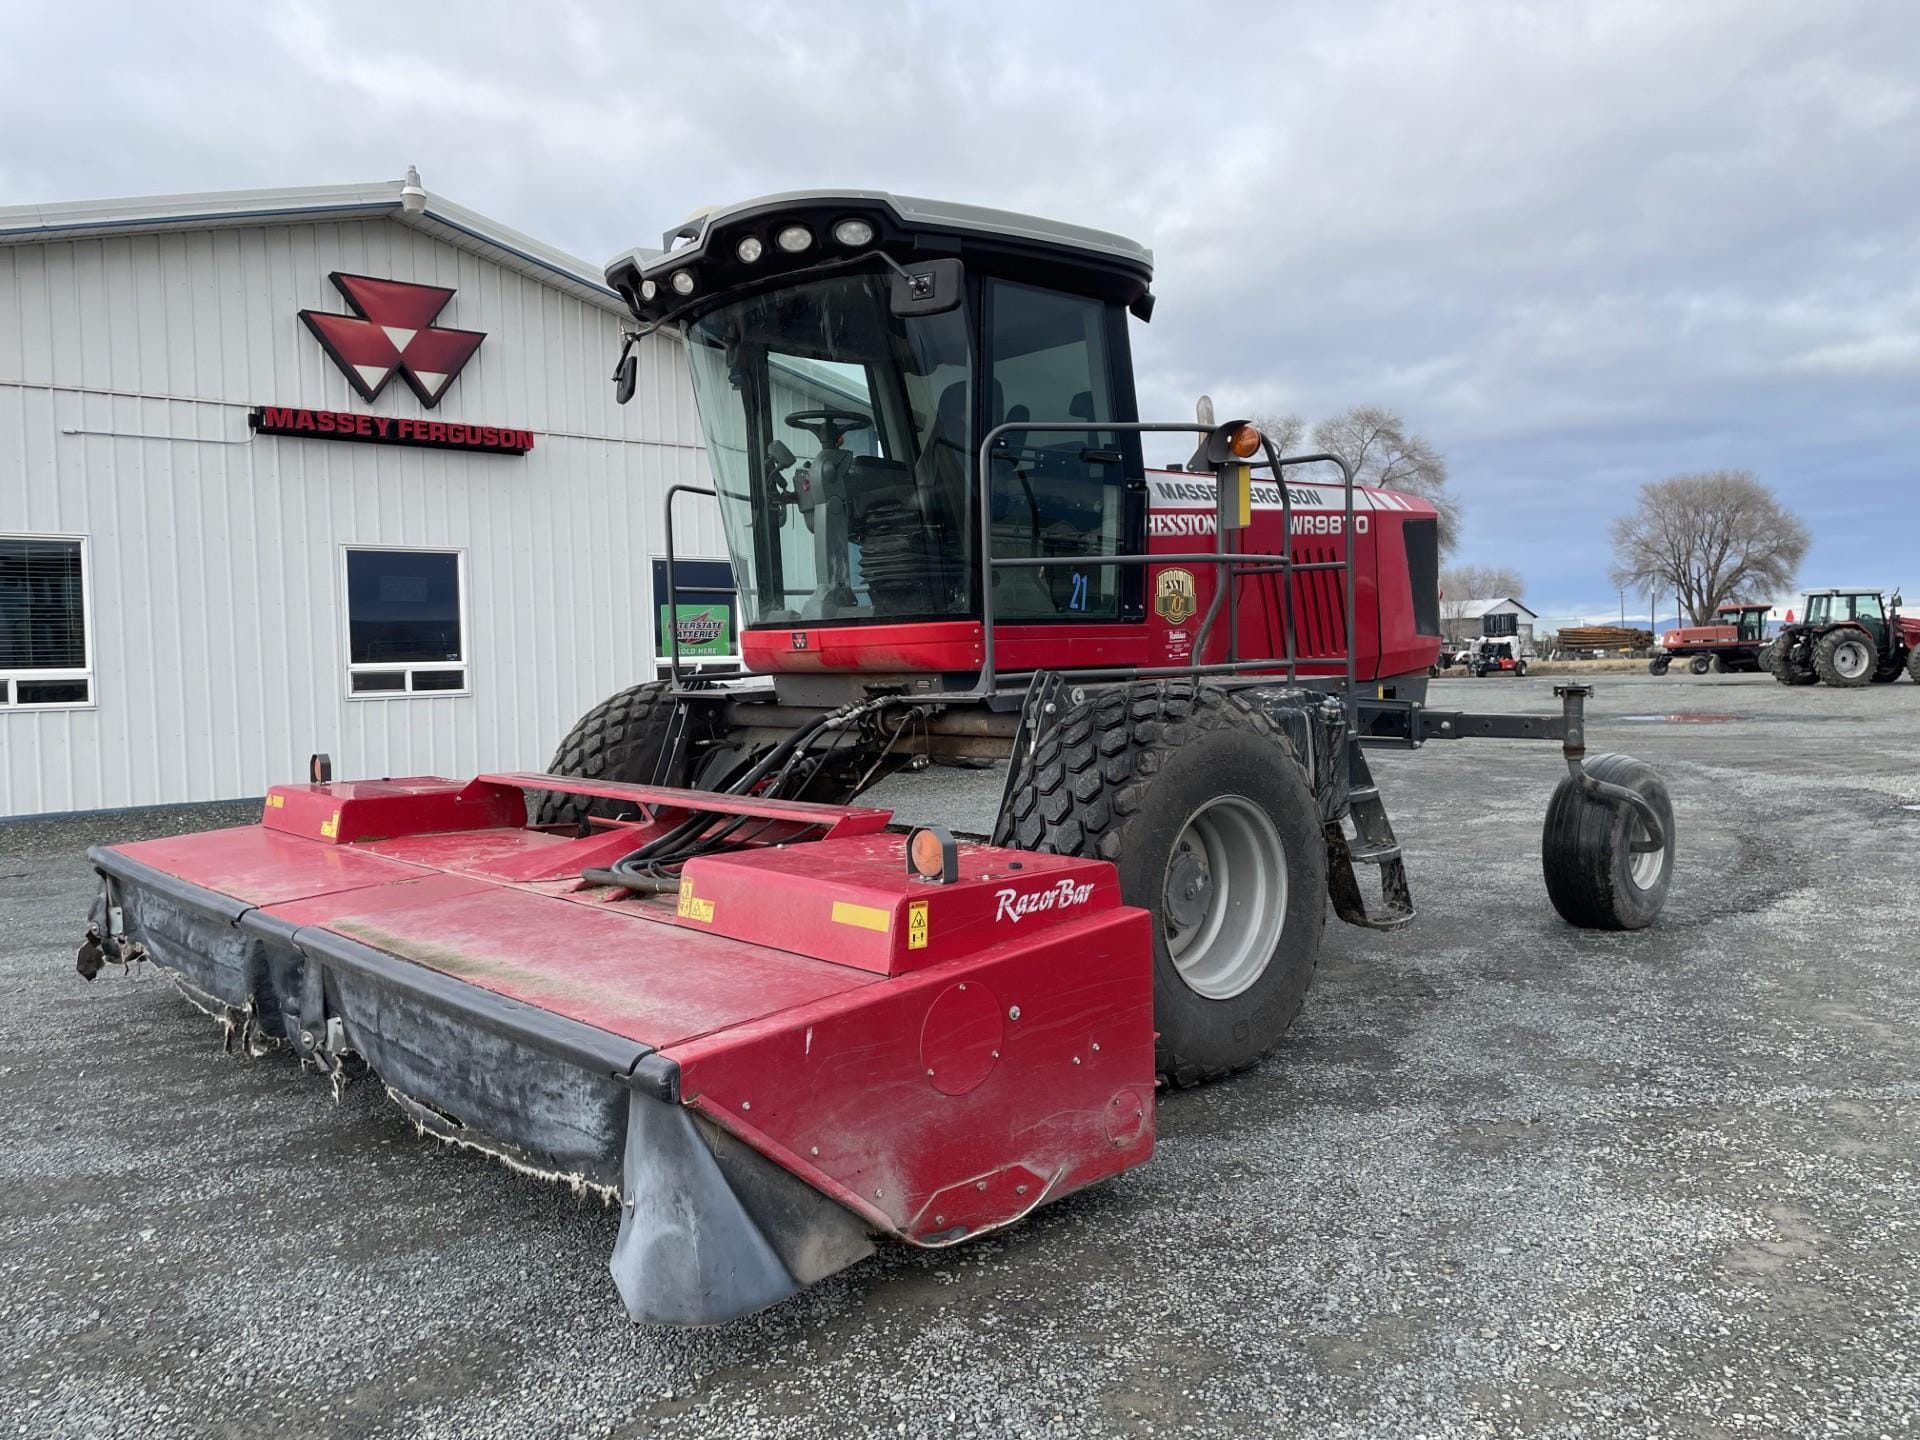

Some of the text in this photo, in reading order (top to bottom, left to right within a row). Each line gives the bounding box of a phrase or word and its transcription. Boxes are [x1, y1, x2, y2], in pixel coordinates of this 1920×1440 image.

[264, 406, 534, 449] MASSEY FERGUSON
[1156, 482, 1324, 505] MASSE ERGSON
[1069, 573, 1088, 611] 21
[677, 630, 719, 638] ATTERIES
